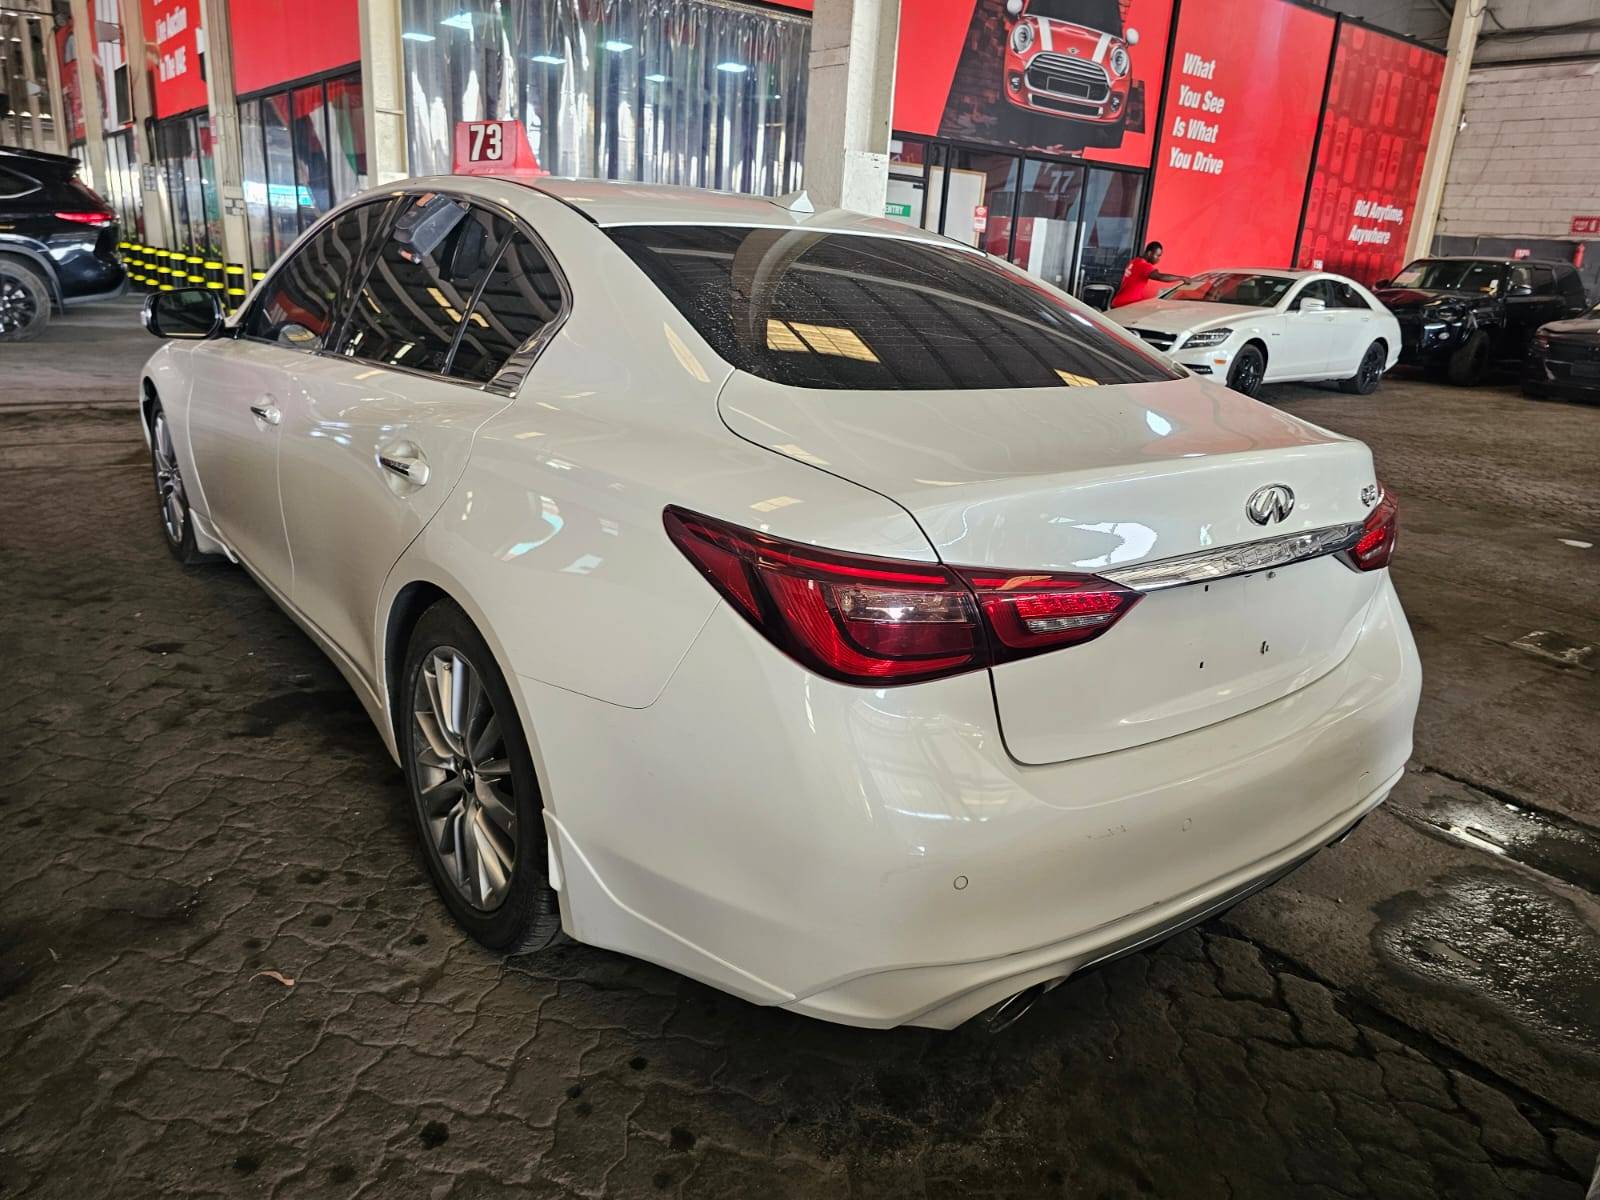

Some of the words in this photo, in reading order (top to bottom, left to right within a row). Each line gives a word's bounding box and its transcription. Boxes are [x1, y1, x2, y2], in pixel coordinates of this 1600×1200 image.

[1182, 52, 1216, 80] What
[1178, 84, 1202, 109] You
[1201, 90, 1225, 114] See
[470, 123, 502, 161] 73
[1172, 115, 1187, 138] Is
[1186, 118, 1219, 144] What
[1169, 146, 1192, 170] You
[1191, 151, 1224, 175] Drive
[1353, 199, 1371, 218] Bid
[1347, 224, 1391, 246] Anywhere
